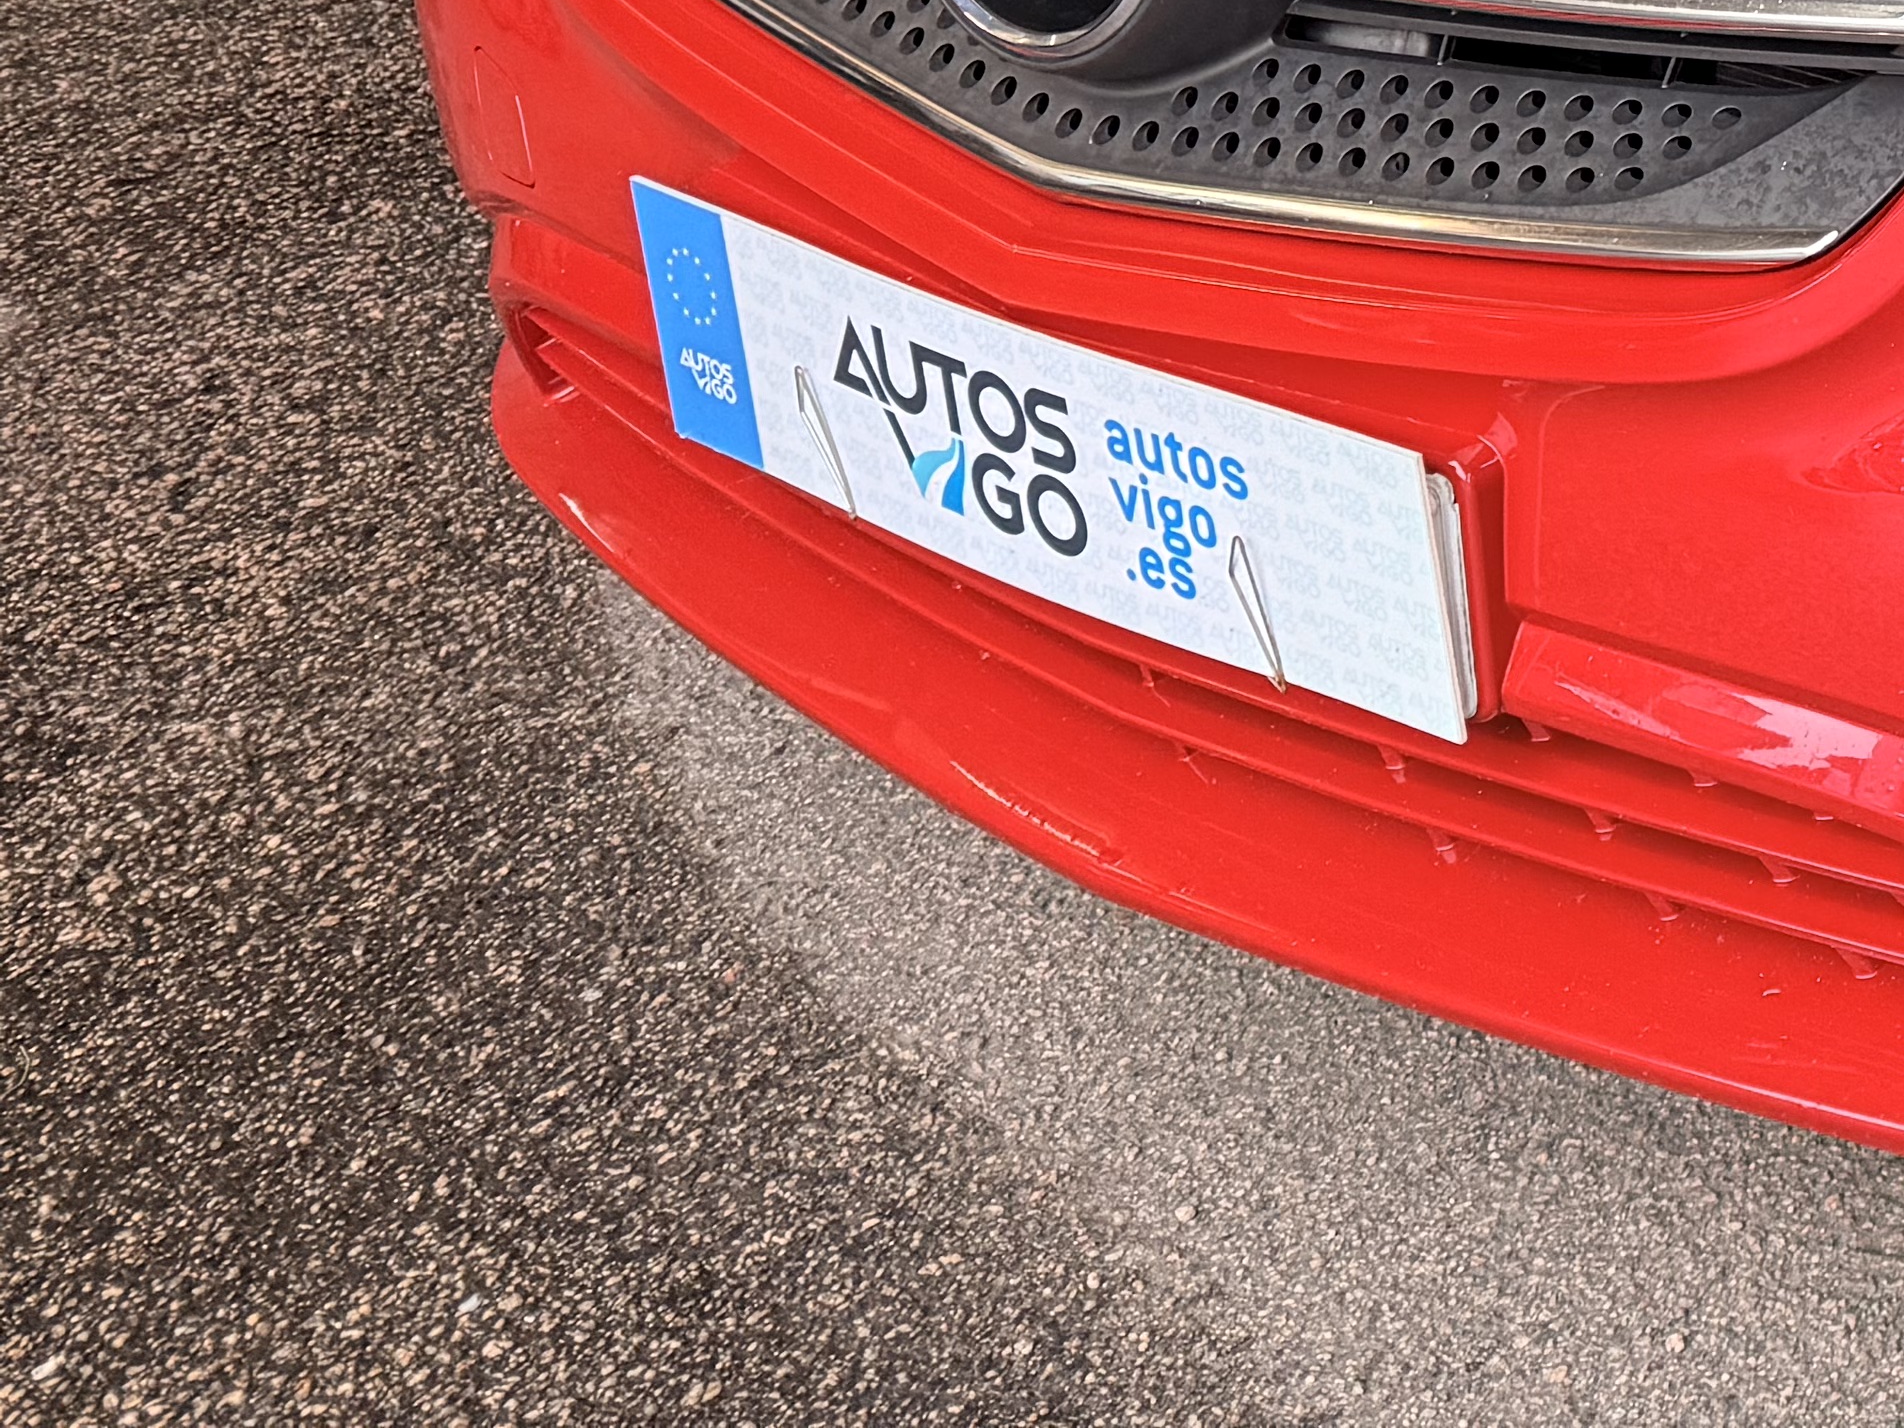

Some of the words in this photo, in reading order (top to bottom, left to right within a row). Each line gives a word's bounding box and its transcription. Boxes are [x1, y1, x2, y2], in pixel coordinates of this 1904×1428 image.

[680, 347, 734, 384] AUTOS
[833, 315, 1078, 476] AUTOS
[882, 408, 1088, 558] VIGO
[1104, 418, 1249, 501] autos
[1109, 473, 1218, 558] vigo
[1126, 546, 1197, 600] .es
